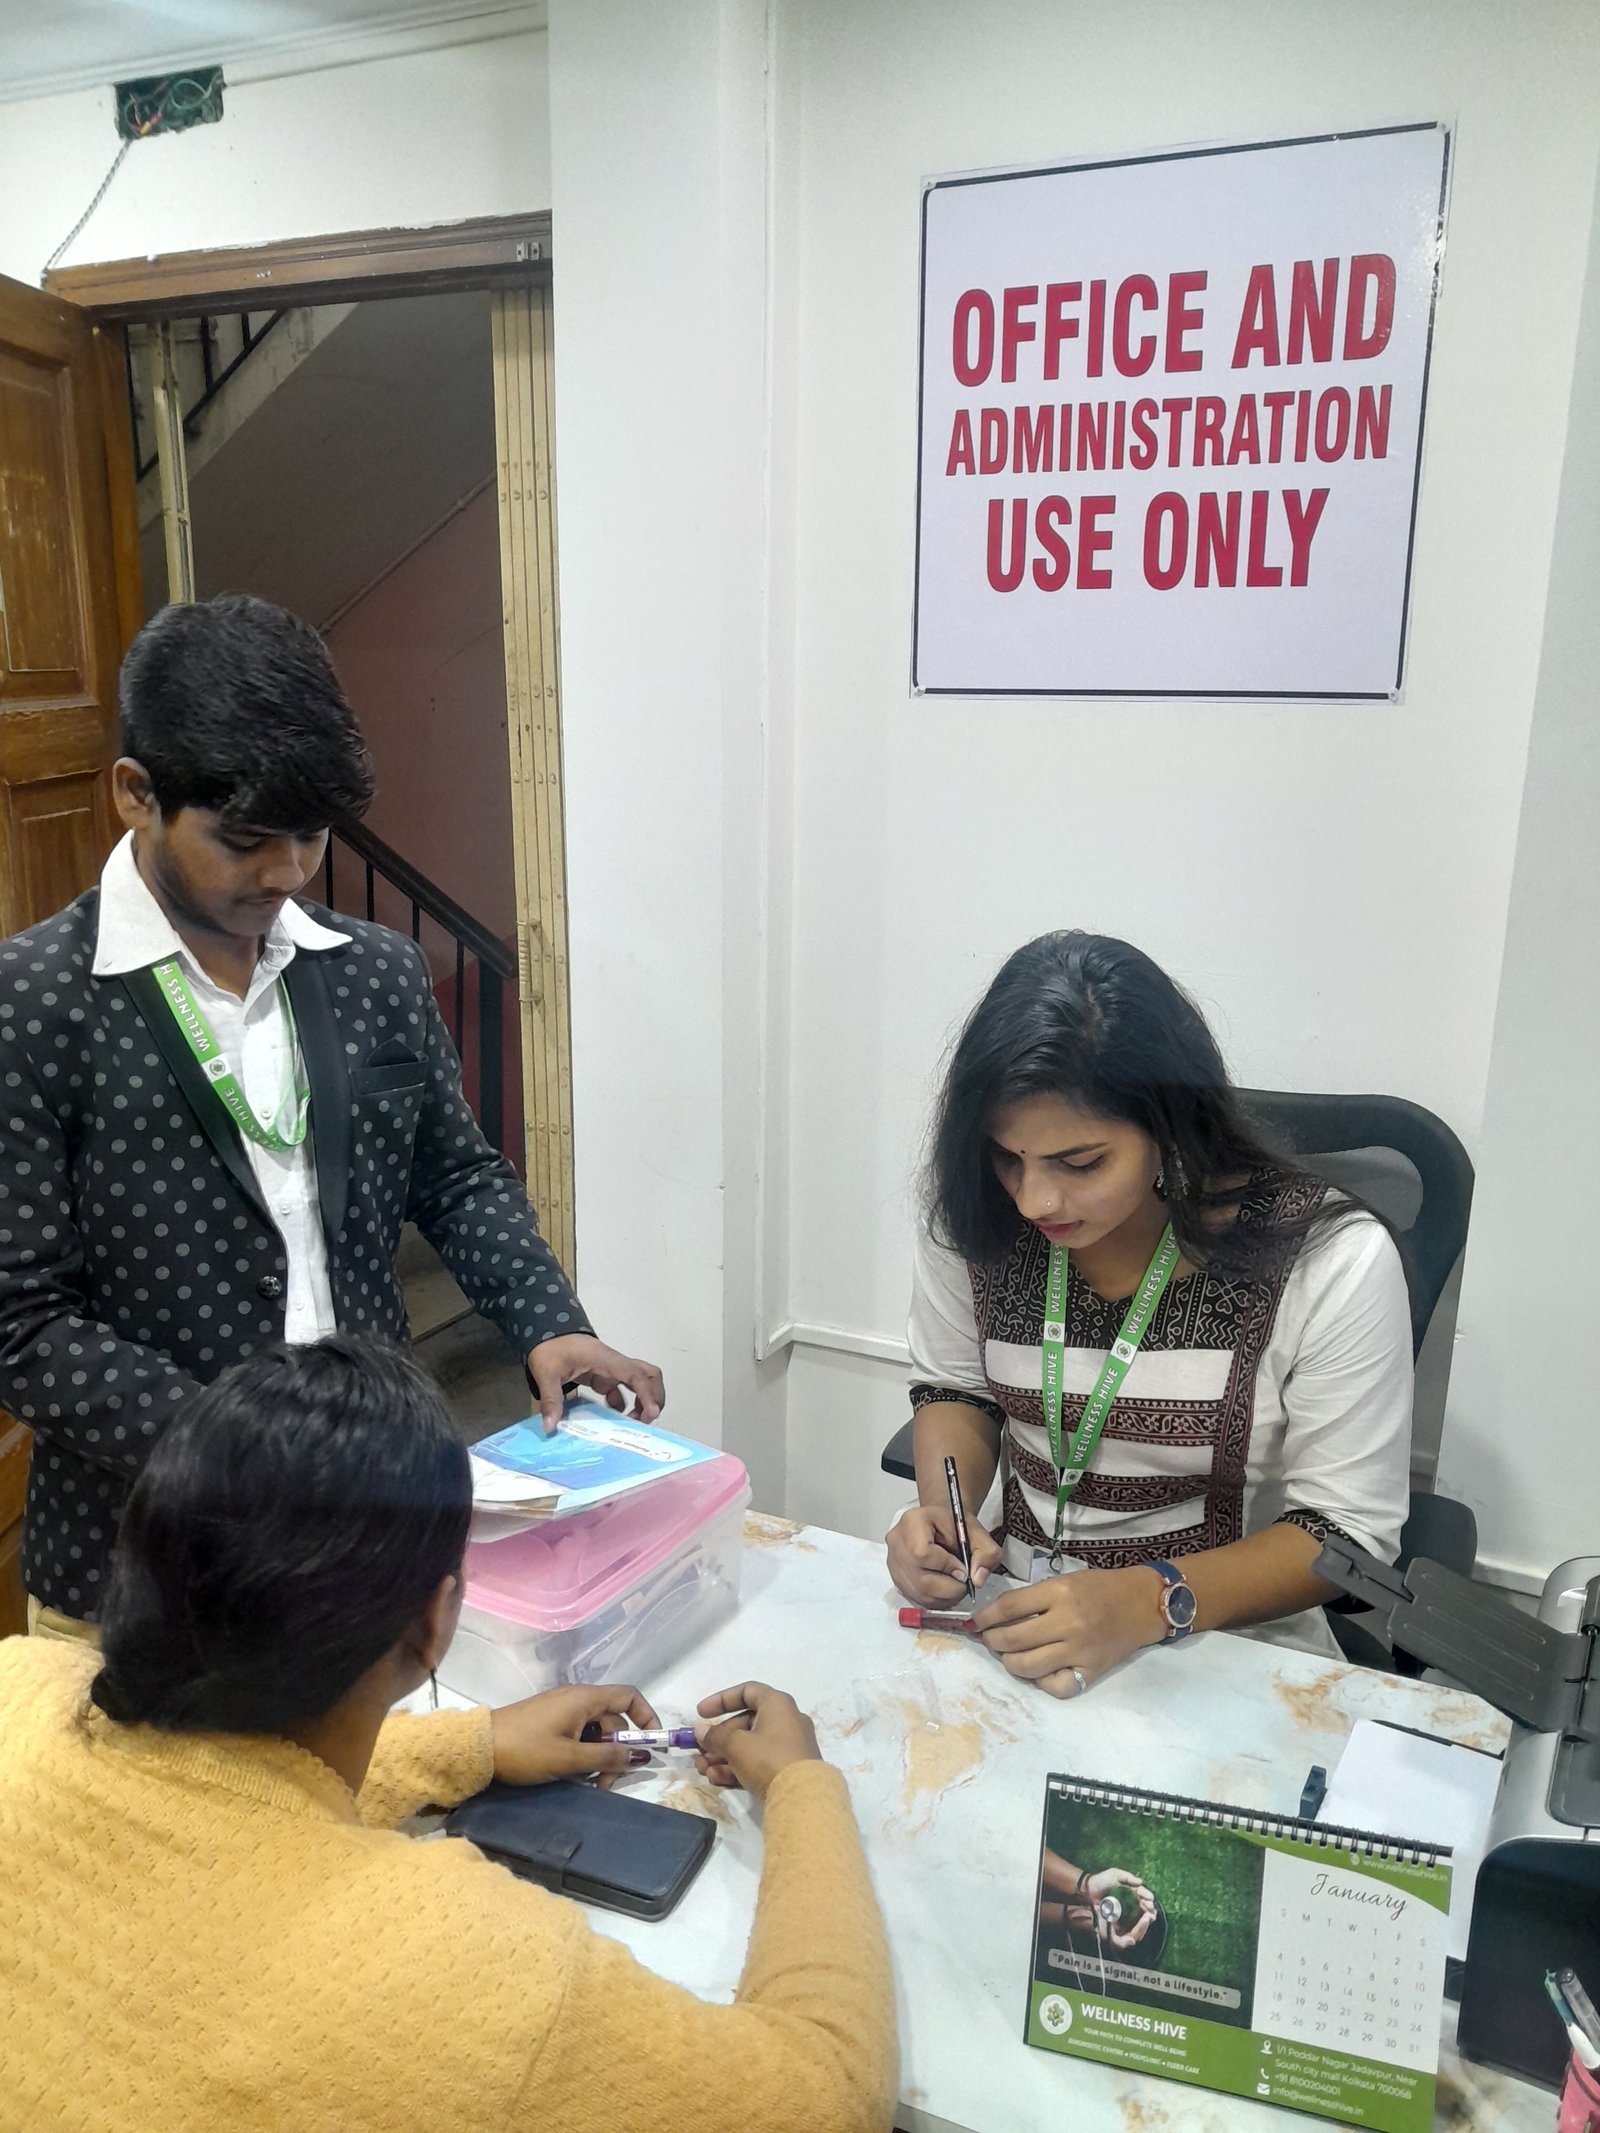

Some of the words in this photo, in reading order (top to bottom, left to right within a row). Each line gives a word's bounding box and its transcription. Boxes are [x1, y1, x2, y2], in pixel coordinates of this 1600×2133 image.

[952, 270, 1208, 387] OFFICE
[1231, 253, 1397, 368] AND
[946, 384, 1393, 476] ADMINISTRATION
[986, 495, 1116, 592] USE
[1143, 488, 1330, 590] ONLY
[167, 978, 211, 1052] WELLNESS
[225, 1087, 249, 1121] HIVE
[1050, 1242, 1064, 1313] WELLNESS
[1126, 1268, 1164, 1335] WELLNESS
[1047, 1352, 1058, 1385] HIVE
[1072, 1401, 1103, 1463] WELLNESS
[1097, 1367, 1119, 1400] HIVE
[1310, 1873, 1408, 1921] January
[1301, 1913, 1311, 1922] M
[1348, 1924, 1358, 1932] W
[1083, 1960, 1092, 1971] is
[1103, 1965, 1140, 1984] signal,
[1143, 1975, 1161, 1986] not
[1164, 1980, 1171, 1989] a
[1322, 1962, 1329, 1971] 6
[1369, 1973, 1375, 1981] 8
[1392, 1977, 1399, 1986] 9
[1415, 1982, 1425, 1992] 10
[1394, 1957, 1401, 1966] 2
[1297, 1976, 1307, 1987] 12
[1320, 1982, 1330, 1992] 13
[1343, 1987, 1353, 1997] 14
[1366, 1991, 1376, 2002] 15
[1390, 1996, 1400, 2007] 16
[1413, 2001, 1423, 2012] 17
[1081, 2002, 1151, 2031] WELLNESS
[1153, 2020, 1187, 2040] HIVE
[1269, 2012, 1281, 2022] 25
[1292, 2016, 1304, 2027] 26
[1315, 2021, 1327, 2032] 27
[1338, 2027, 1350, 2037] 28
[1361, 2032, 1373, 2042] 29
[1385, 2037, 1397, 2048] 30
[1317, 2001, 1329, 2012] 20
[1340, 2007, 1350, 2017] 21
[1363, 2012, 1375, 2022] 22
[1386, 2017, 1398, 2028] 23
[1410, 2023, 1422, 2033] 24
[1275, 2058, 1301, 2072] South
[1303, 2066, 1319, 2078] city
[1342, 2074, 1375, 2091] Kolkata
[1288, 2047, 1320, 2063] Poddar
[1322, 2055, 1349, 2070] Nagar
[1396, 2073, 1418, 2087] Near
